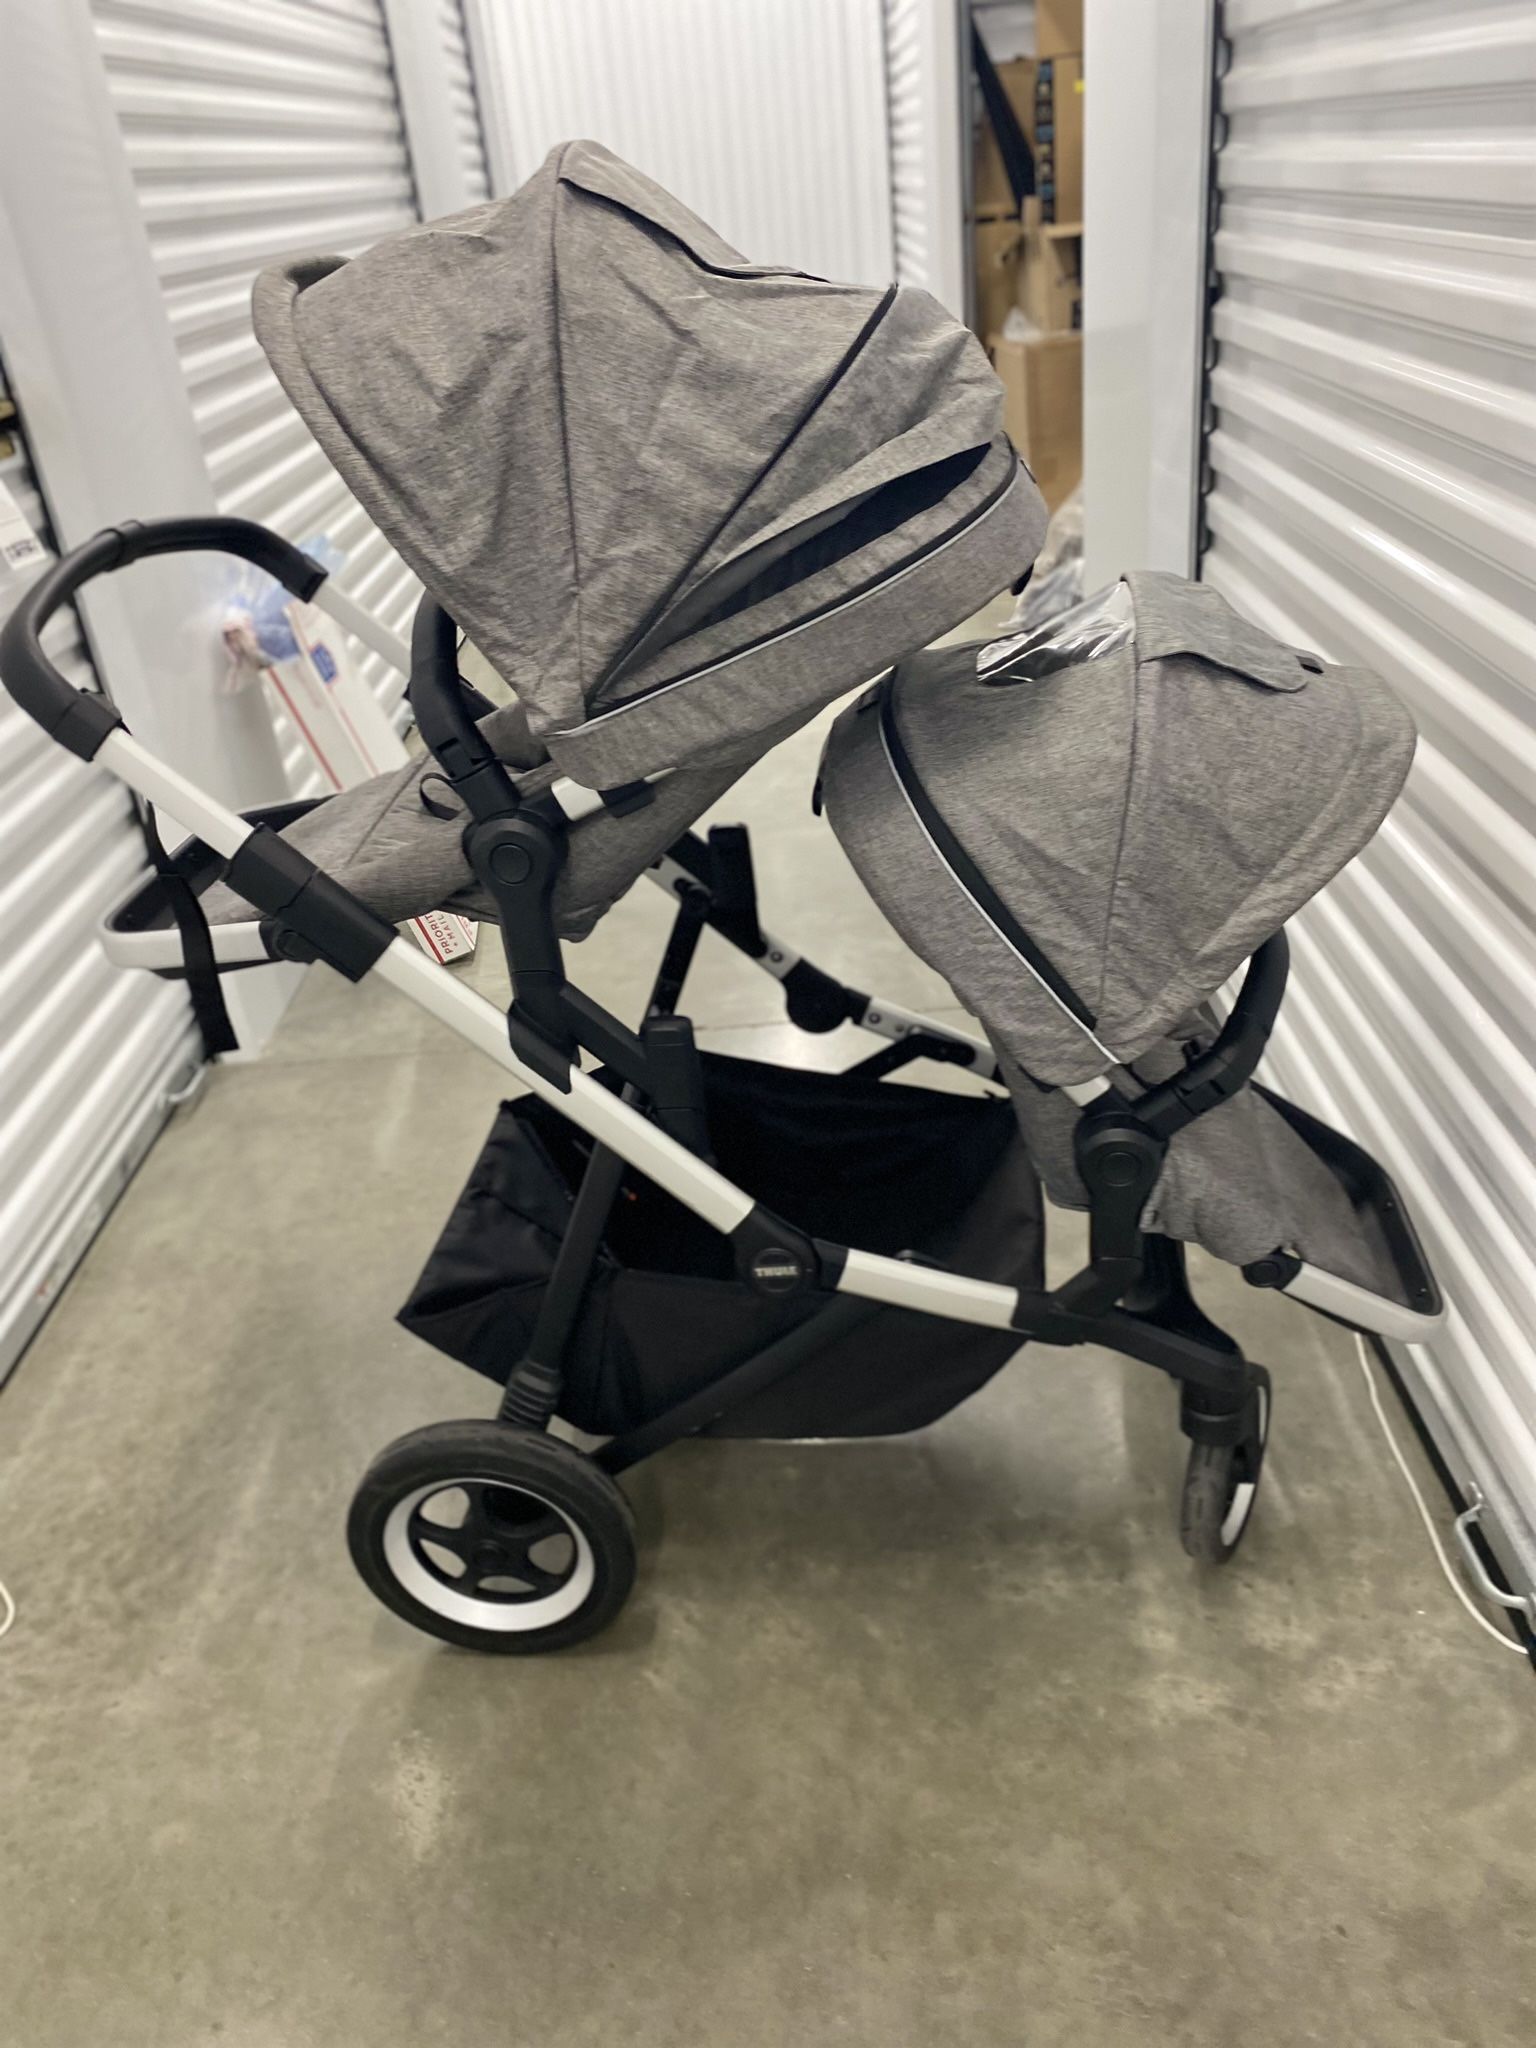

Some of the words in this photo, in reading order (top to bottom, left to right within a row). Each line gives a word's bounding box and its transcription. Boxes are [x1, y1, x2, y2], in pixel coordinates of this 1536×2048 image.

[424, 914, 454, 955] PRIORIT
[438, 914, 456, 940] MAIL
[754, 1265, 799, 1277] THULE
